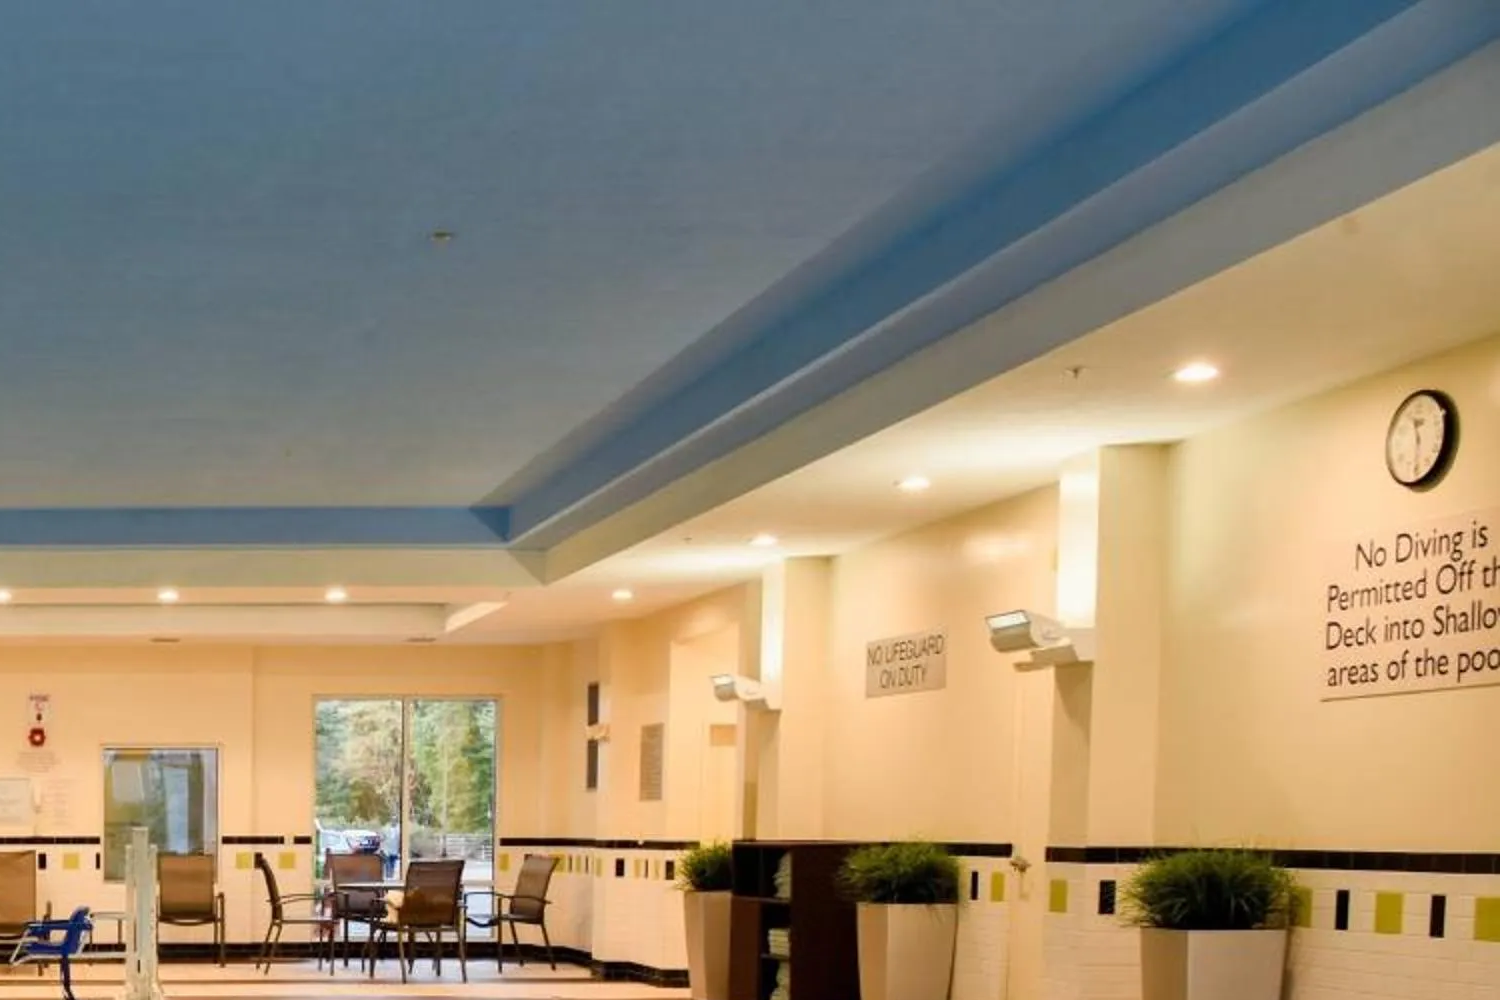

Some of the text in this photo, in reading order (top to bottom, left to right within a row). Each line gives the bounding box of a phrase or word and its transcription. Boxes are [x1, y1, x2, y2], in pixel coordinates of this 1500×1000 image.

[1355, 520, 1489, 571] No Diving is
[1327, 556, 1500, 613] Permitted Off th
[1325, 600, 1500, 651] Deck into Shallo
[1327, 647, 1500, 687] areas of the poo
